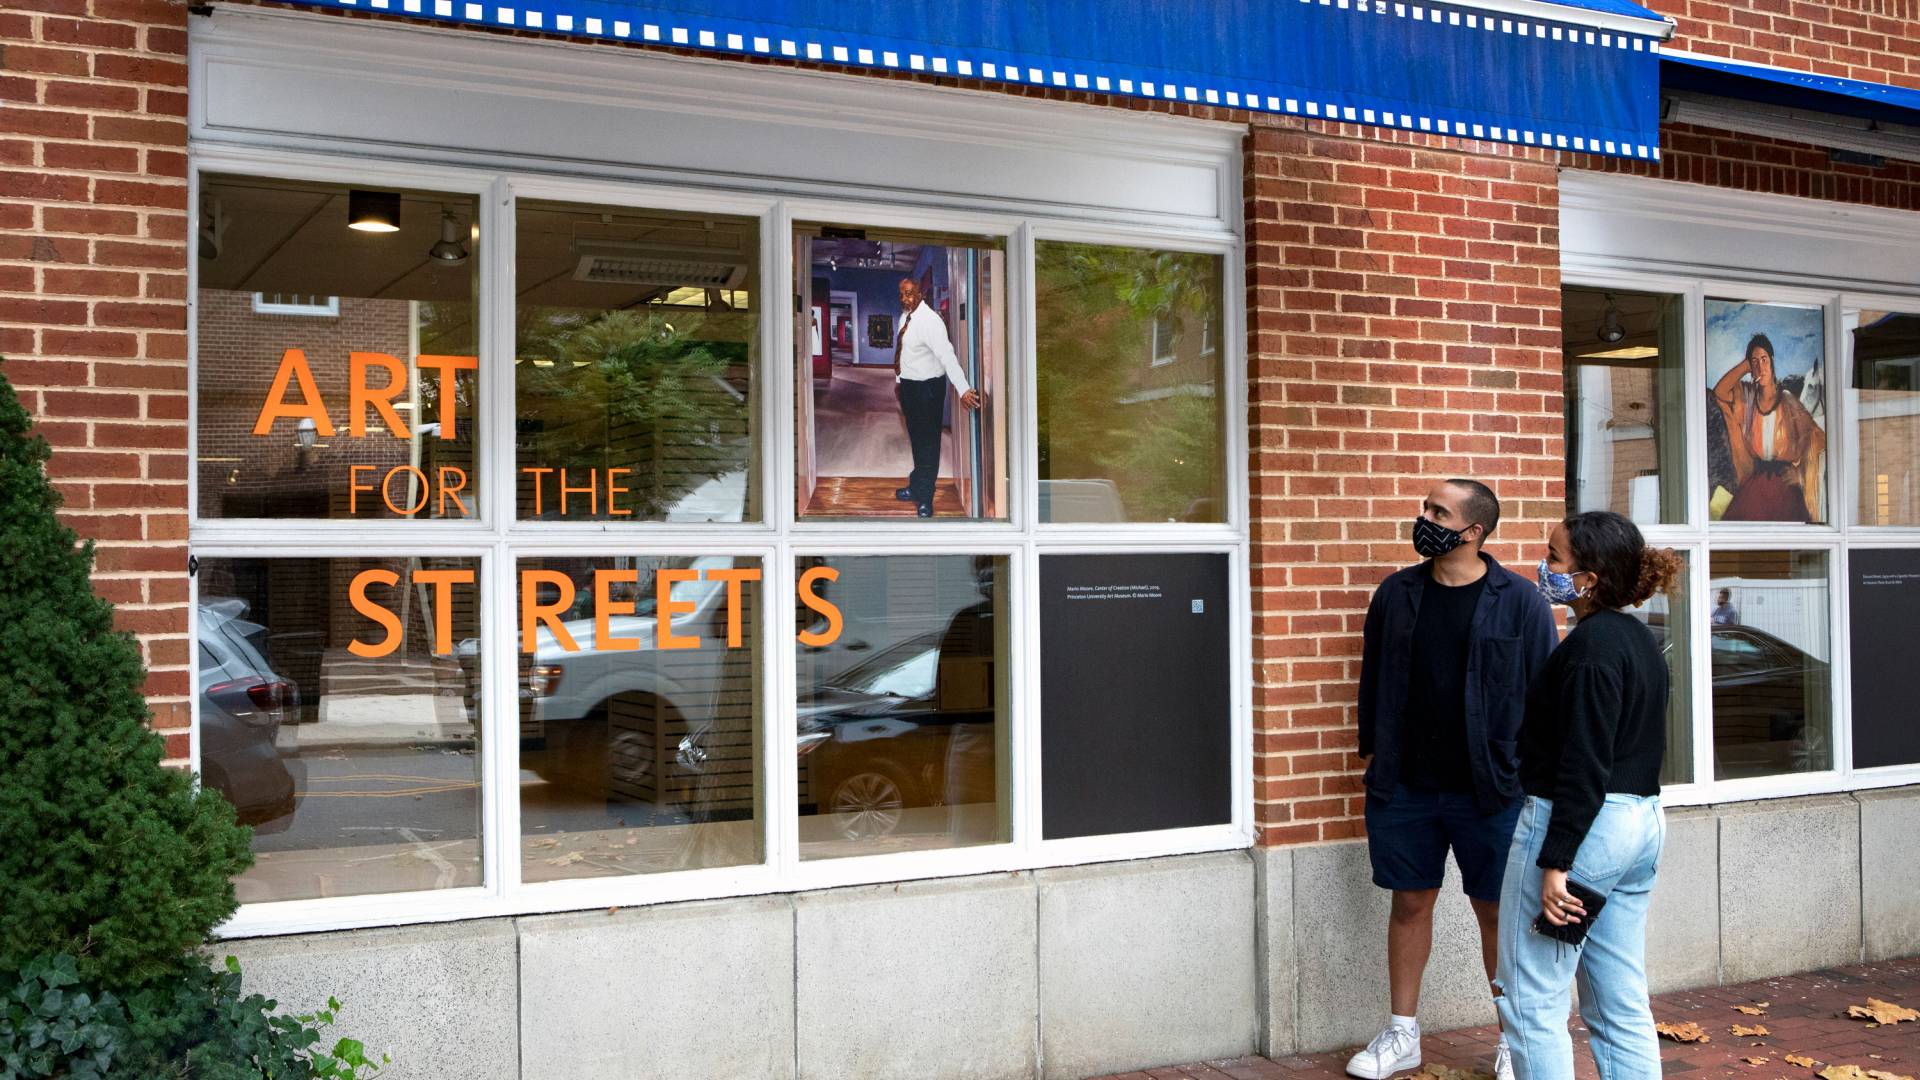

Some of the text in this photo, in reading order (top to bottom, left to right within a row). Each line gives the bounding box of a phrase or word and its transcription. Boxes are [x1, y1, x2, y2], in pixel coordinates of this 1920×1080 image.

[253, 348, 478, 440] ART
[350, 465, 632, 515] FOR THE
[347, 566, 843, 658] STREETS
